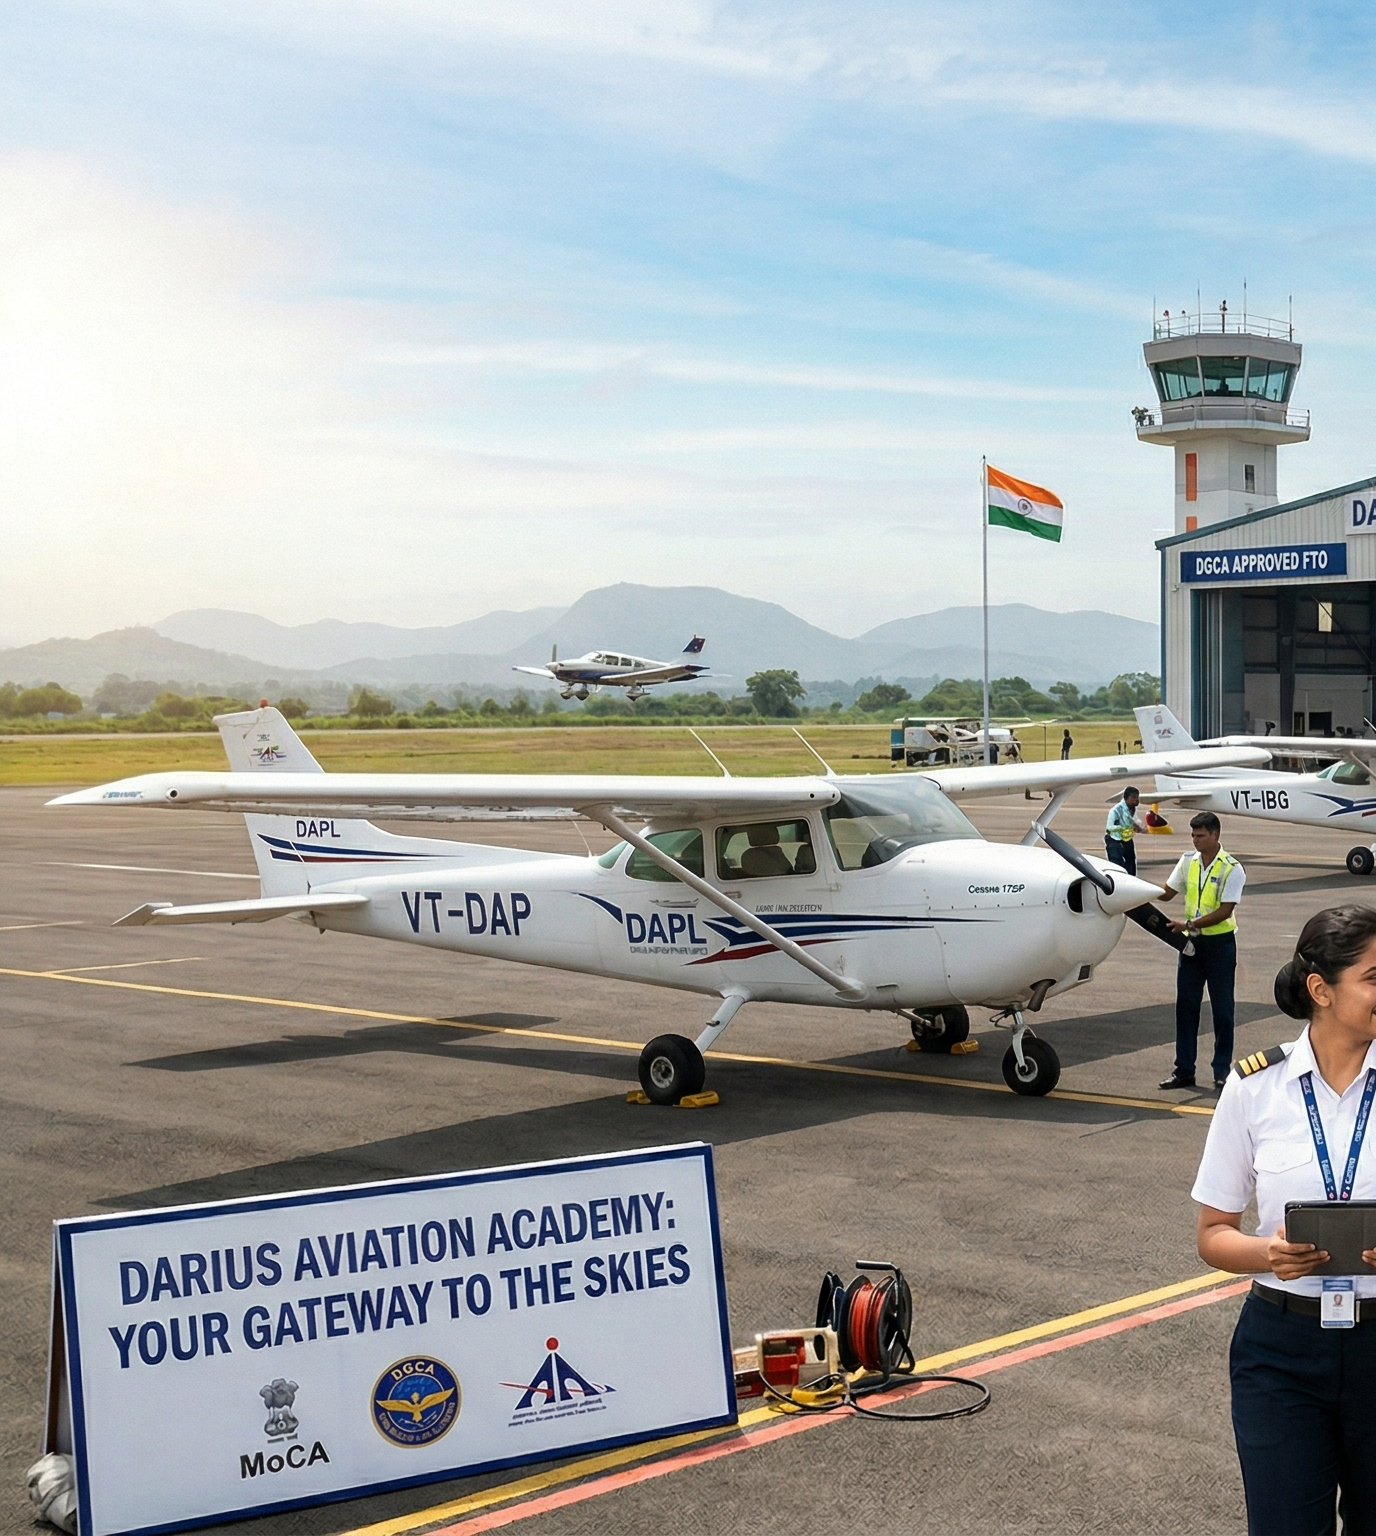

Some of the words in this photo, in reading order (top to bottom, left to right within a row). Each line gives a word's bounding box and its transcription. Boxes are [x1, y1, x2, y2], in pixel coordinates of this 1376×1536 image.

[1196, 556, 1230, 575] DGCA
[1232, 551, 1300, 573] APPROVED
[1302, 550, 1328, 570] FTO
[1230, 790, 1289, 810] VT-IBG
[296, 820, 341, 838] DAPL
[401, 890, 532, 937] VT-DAP
[625, 913, 708, 945] DAPL
[119, 1242, 283, 1306] DARIUS
[294, 1216, 476, 1282] AVIATION
[487, 1191, 676, 1255] ACADEMY:
[108, 1312, 232, 1369] YOUR
[242, 1281, 434, 1350] GATEWAY
[441, 1273, 491, 1319] TO
[500, 1260, 576, 1310] THE
[583, 1244, 691, 1298] SKIES
[391, 1361, 436, 1381] DGCA
[240, 1441, 331, 1479] MoCA
